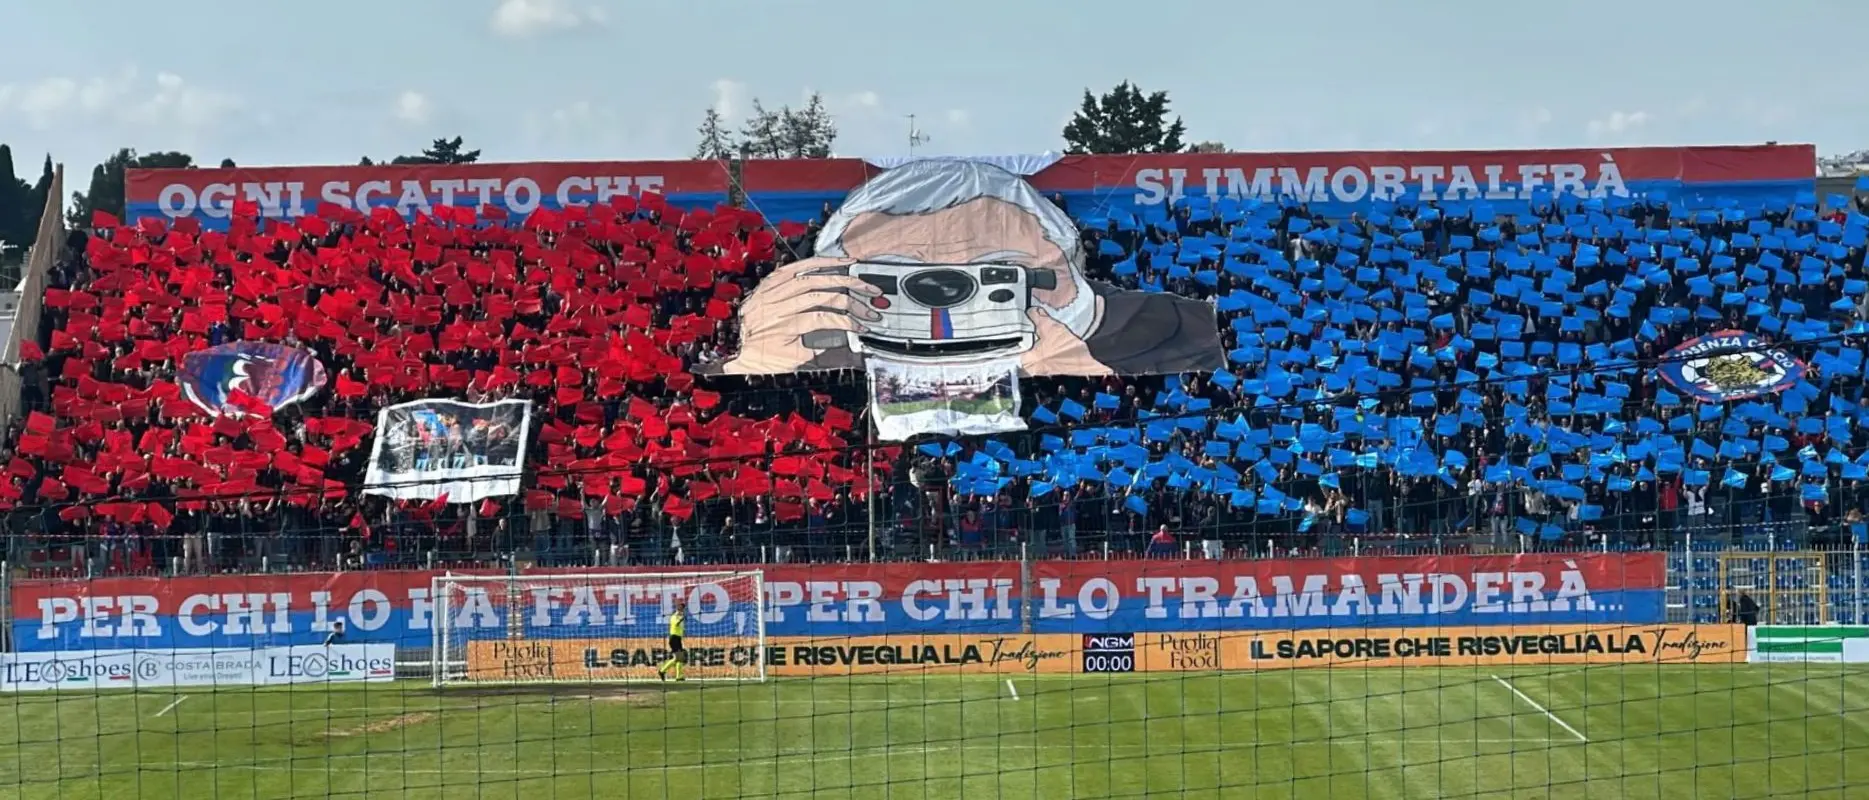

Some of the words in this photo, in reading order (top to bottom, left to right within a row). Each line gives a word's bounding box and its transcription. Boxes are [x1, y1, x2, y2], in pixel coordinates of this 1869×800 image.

[1135, 168, 1187, 205] SI
[158, 182, 305, 218] OGNI
[321, 177, 541, 216] SCATTO
[37, 595, 162, 639] PER
[178, 592, 292, 636] CHI
[311, 589, 391, 632] LO
[408, 586, 500, 629] HA
[531, 583, 747, 635] FATTO,
[762, 581, 886, 623] PER
[901, 577, 1014, 621] CHI
[1039, 577, 1120, 620] LO
[1137, 559, 1623, 618] TRAMANDERÀ...
[493, 641, 552, 662] Puglia
[584, 648, 608, 668] IL
[729, 646, 786, 666] CHE
[793, 644, 942, 666] RISVEGLIA
[944, 644, 983, 664] LA
[979, 637, 1066, 670] Tradizione
[1160, 633, 1218, 654] Puglia
[1250, 639, 1274, 659] IL
[1277, 638, 1390, 659] SAPORE
[1394, 637, 1450, 657] CHE
[1457, 634, 1604, 656] RISVEGLIA
[1608, 634, 1646, 655] LA
[1643, 628, 1726, 660] Tradizione
[165, 661, 211, 671] COSTA
[504, 658, 552, 677] Food
[1086, 656, 1132, 671] 00:00
[1171, 652, 1218, 669] Food
